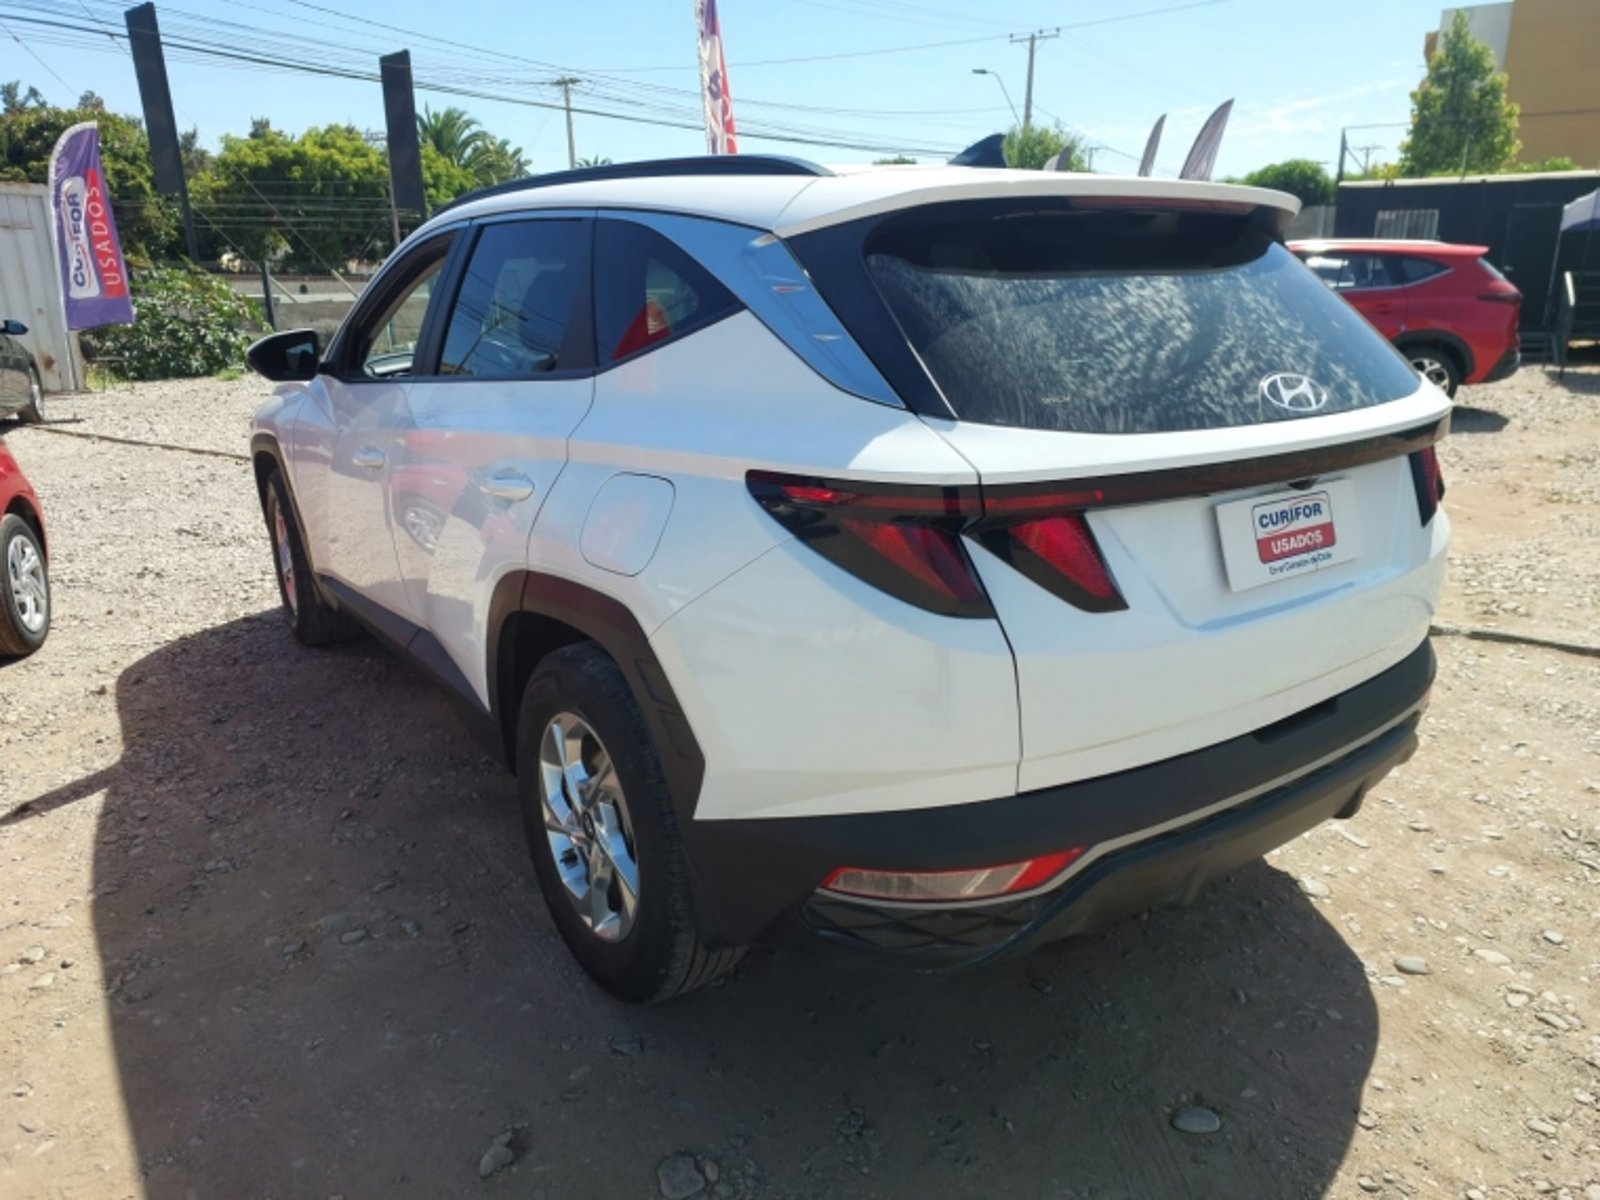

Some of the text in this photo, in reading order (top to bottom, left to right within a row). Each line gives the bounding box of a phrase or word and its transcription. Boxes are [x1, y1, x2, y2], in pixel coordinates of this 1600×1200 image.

[86, 186, 121, 285] USADOS
[1258, 502, 1323, 529] CURIFOR
[1271, 530, 1323, 555] USADOS
